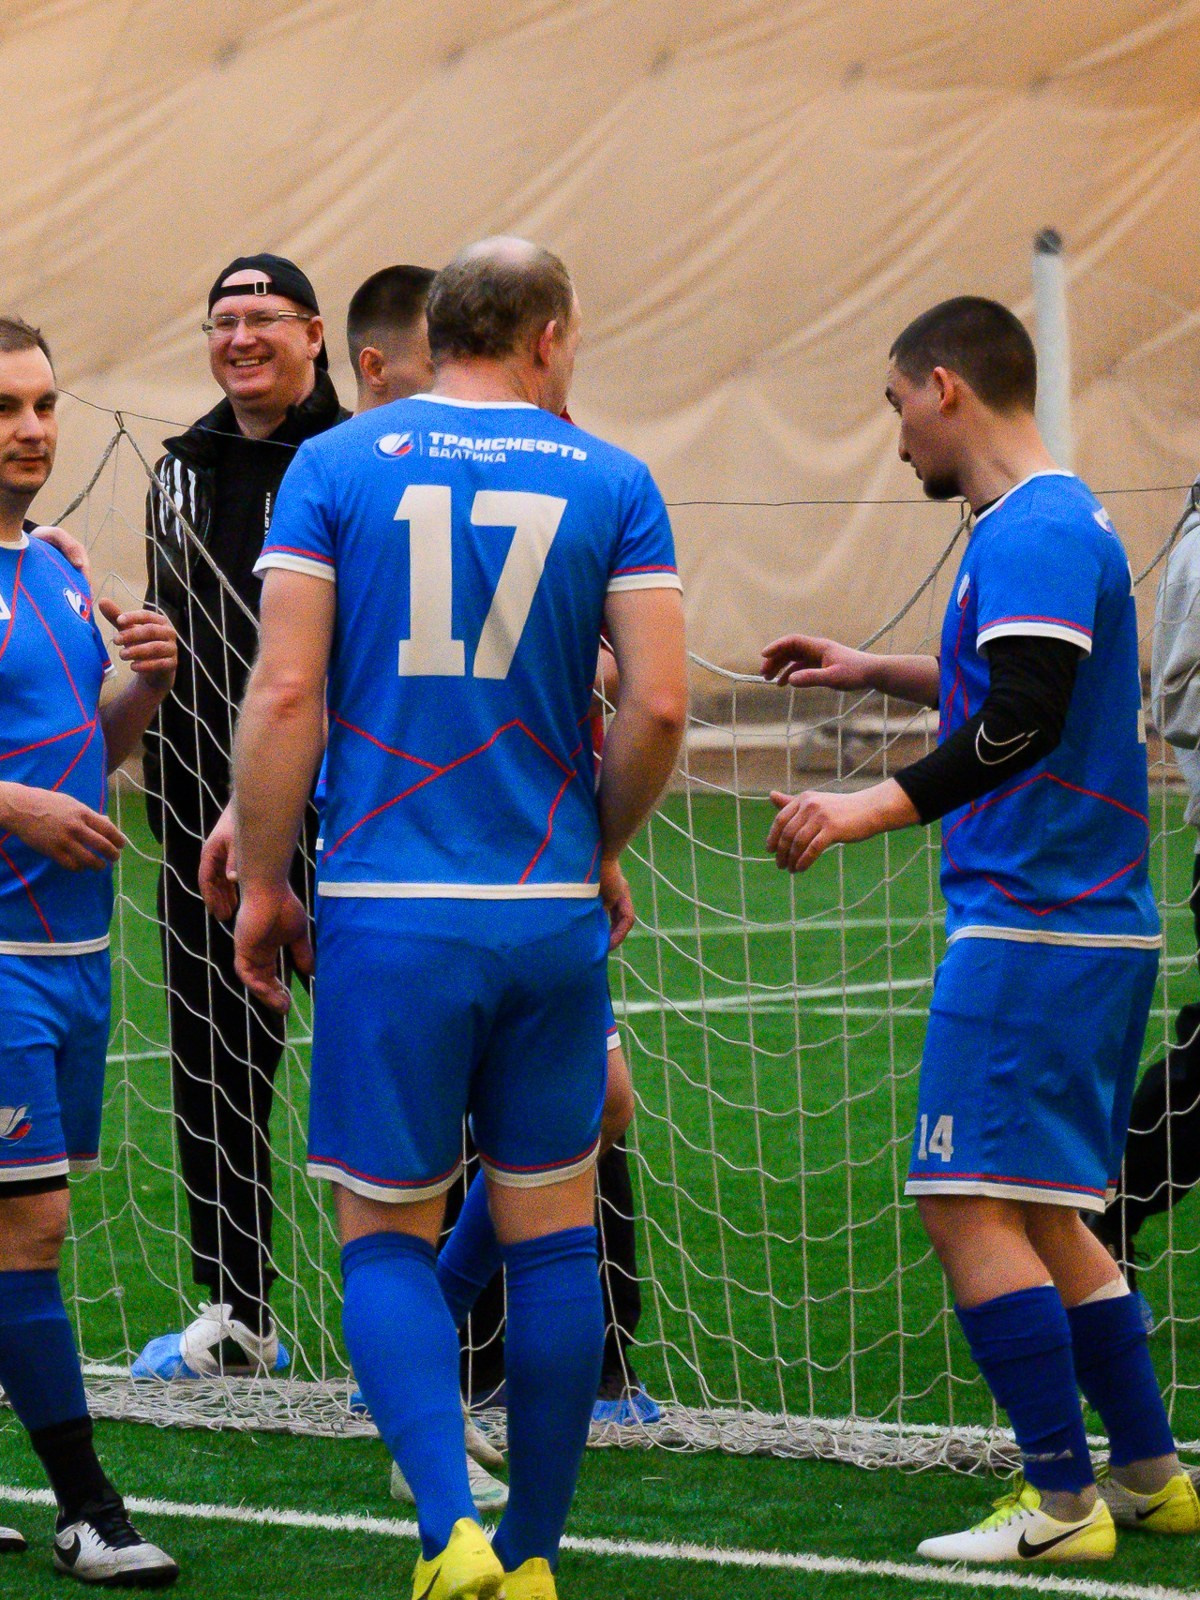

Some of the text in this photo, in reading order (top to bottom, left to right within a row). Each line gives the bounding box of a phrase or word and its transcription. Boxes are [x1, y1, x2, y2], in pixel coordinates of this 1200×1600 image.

[428, 431, 588, 461] ТРАНСНЕФТЬ
[428, 446, 506, 463] БАЛТИКА
[393, 484, 568, 680] 17
[917, 1113, 954, 1162] 14
